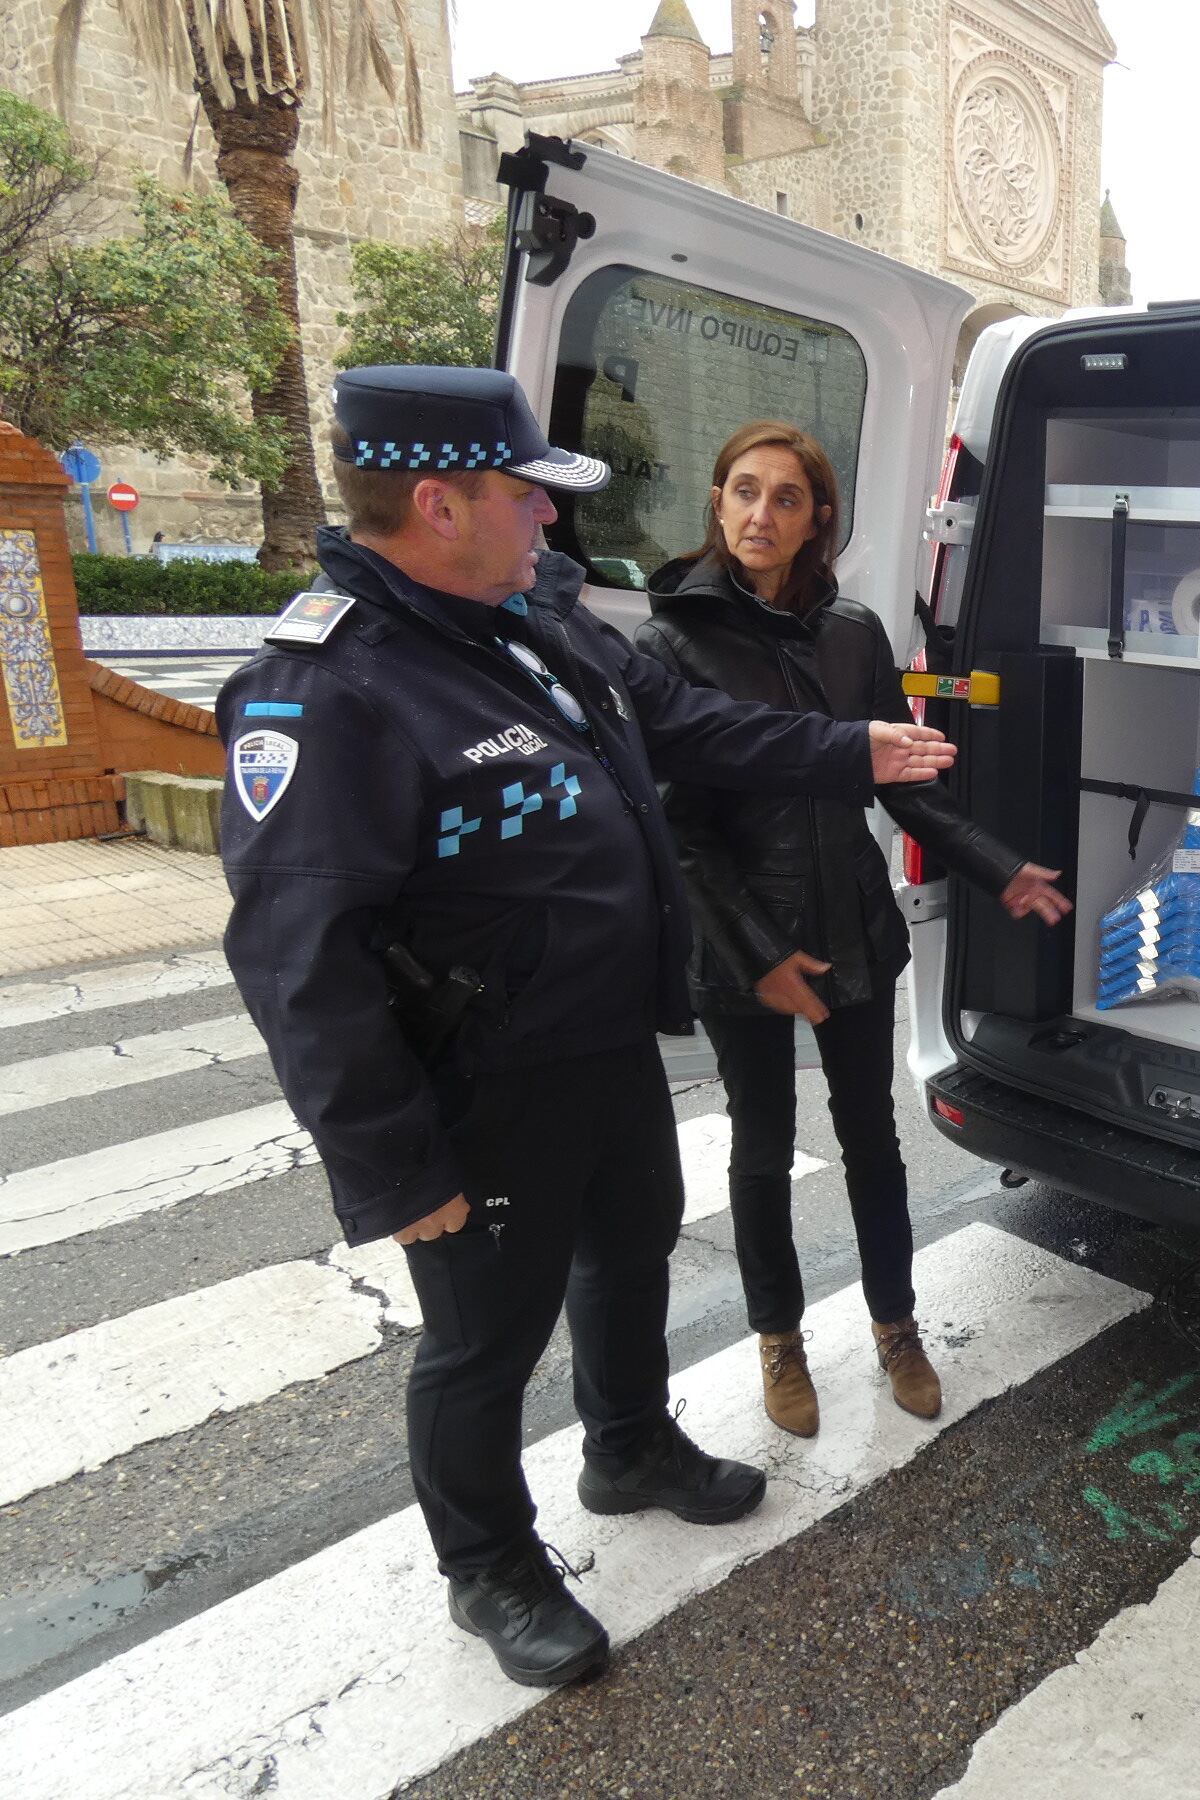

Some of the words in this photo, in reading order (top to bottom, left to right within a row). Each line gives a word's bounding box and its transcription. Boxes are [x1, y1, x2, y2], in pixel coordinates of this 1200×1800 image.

[462, 723, 538, 764] POLICIA
[517, 737, 548, 756] LOCAL
[485, 1197, 511, 1207] CPL
